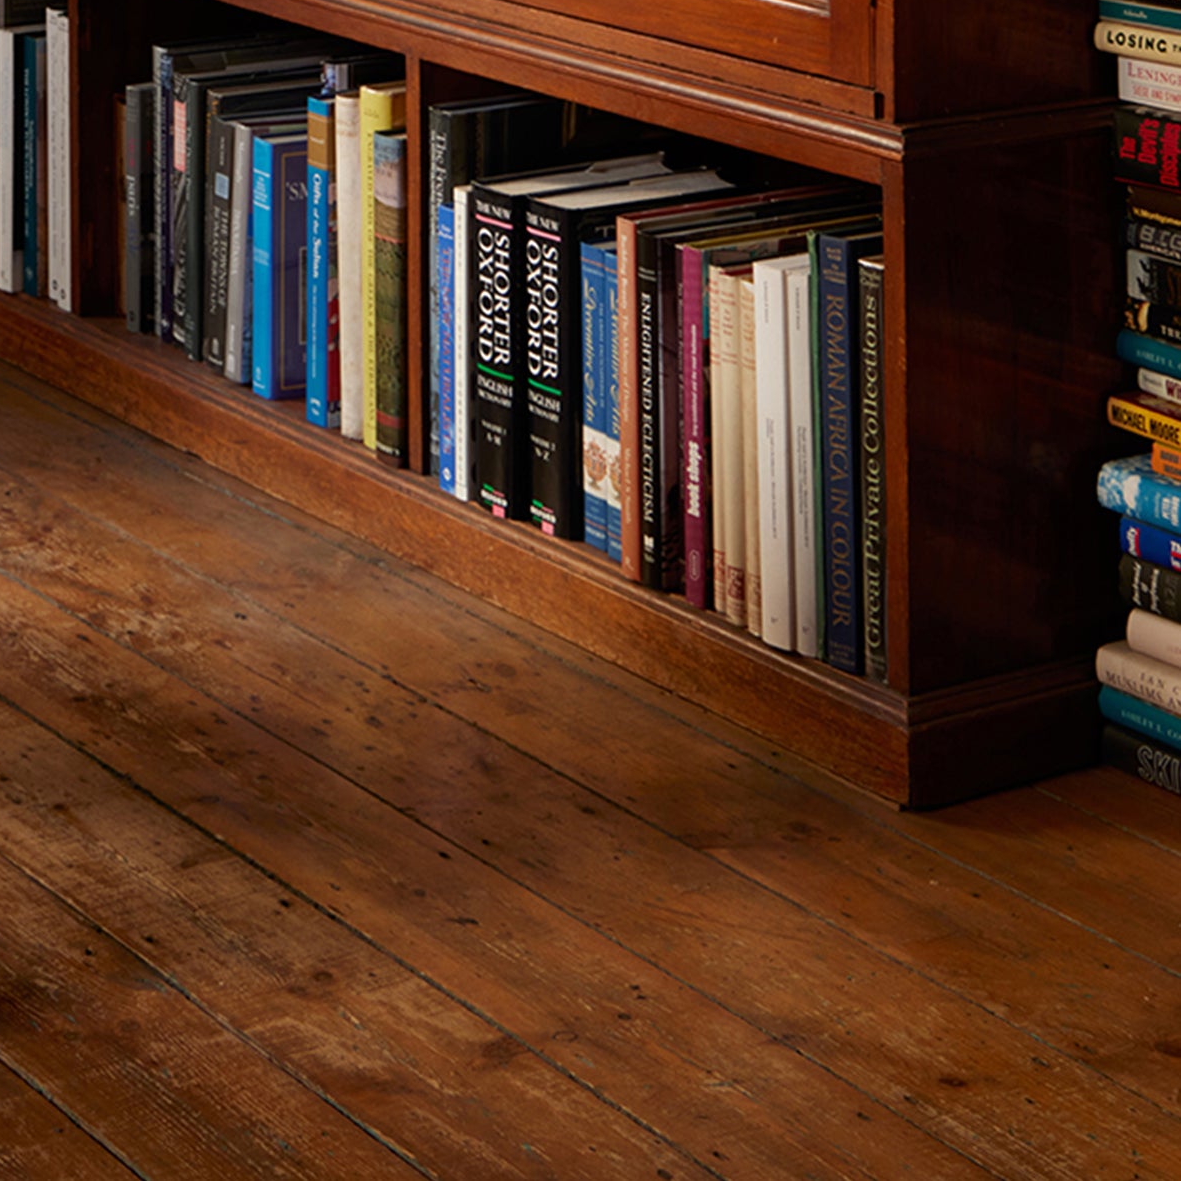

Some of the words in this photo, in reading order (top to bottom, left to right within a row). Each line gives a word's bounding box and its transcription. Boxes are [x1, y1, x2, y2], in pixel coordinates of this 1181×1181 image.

[1106, 30, 1169, 54] LOSING
[312, 172, 323, 205] Gifts
[435, 131, 447, 160] The
[1119, 135, 1137, 160] The
[312, 236, 323, 279] Sultan
[476, 226, 495, 363] OXFORD
[493, 231, 512, 366] SHORTER
[525, 237, 544, 377] OXFORD
[541, 242, 560, 380] SHORTER
[825, 294, 848, 390] ROMAN
[640, 291, 654, 410] ENLIGHTENED
[860, 294, 881, 454] Collections
[642, 412, 655, 524] ECLECTICISM
[685, 440, 702, 483] shops
[827, 392, 849, 482] AFRICA
[1111, 404, 1148, 434] MICHAEL
[1149, 418, 1181, 446] MOORE
[686, 482, 701, 518] book
[829, 488, 850, 517] IN
[861, 457, 882, 564] Private
[830, 521, 852, 627] COLOUR
[863, 567, 883, 649] Great
[1136, 744, 1181, 796] SKI
